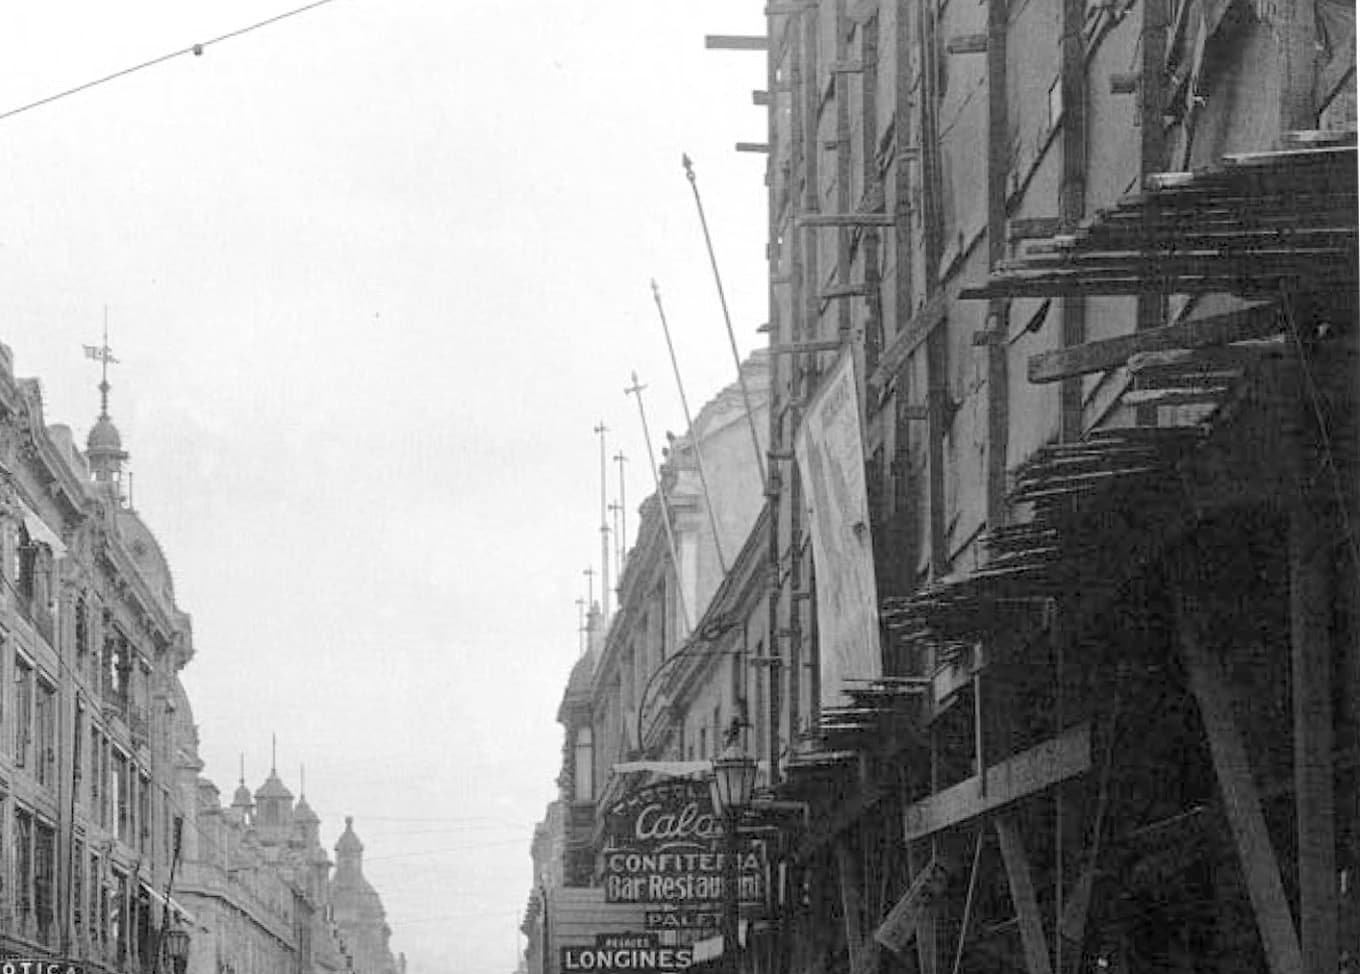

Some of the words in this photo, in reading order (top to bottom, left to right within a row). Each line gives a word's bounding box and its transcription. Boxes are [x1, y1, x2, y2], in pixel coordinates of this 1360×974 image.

[608, 874, 646, 899] Bar
[649, 873, 761, 900] Restaunt
[565, 950, 692, 970] LONGINES
